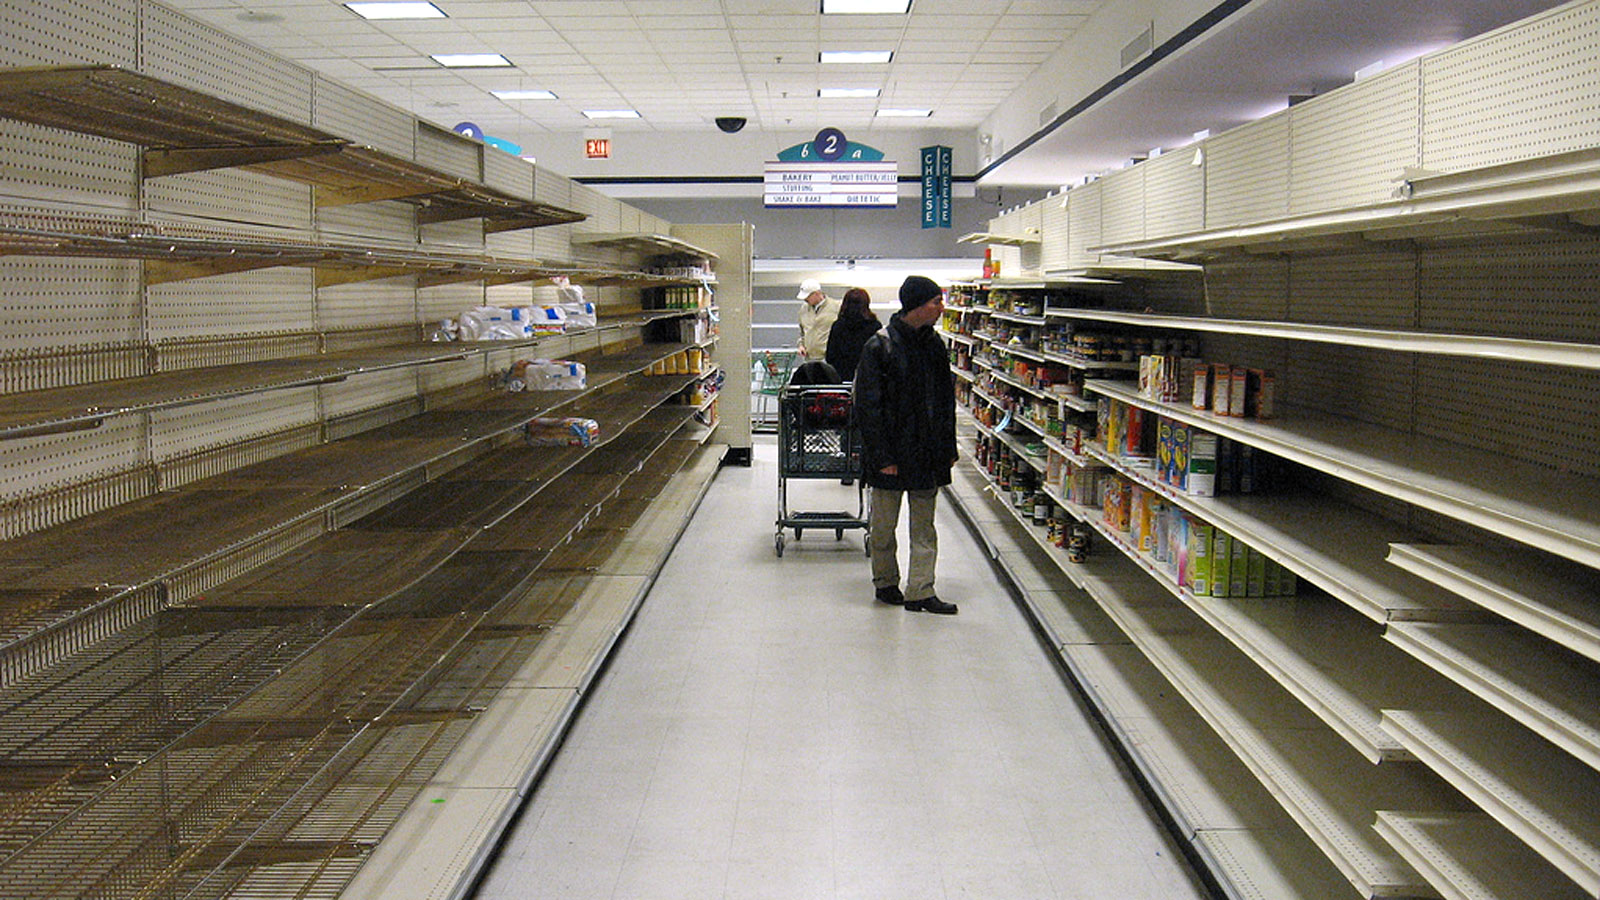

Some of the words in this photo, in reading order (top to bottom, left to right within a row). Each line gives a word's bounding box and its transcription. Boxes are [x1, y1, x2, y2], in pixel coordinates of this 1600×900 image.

[586, 139, 609, 154] EXIT
[823, 135, 838, 154] 2
[852, 149, 862, 158] a
[925, 154, 933, 222] CHEESE
